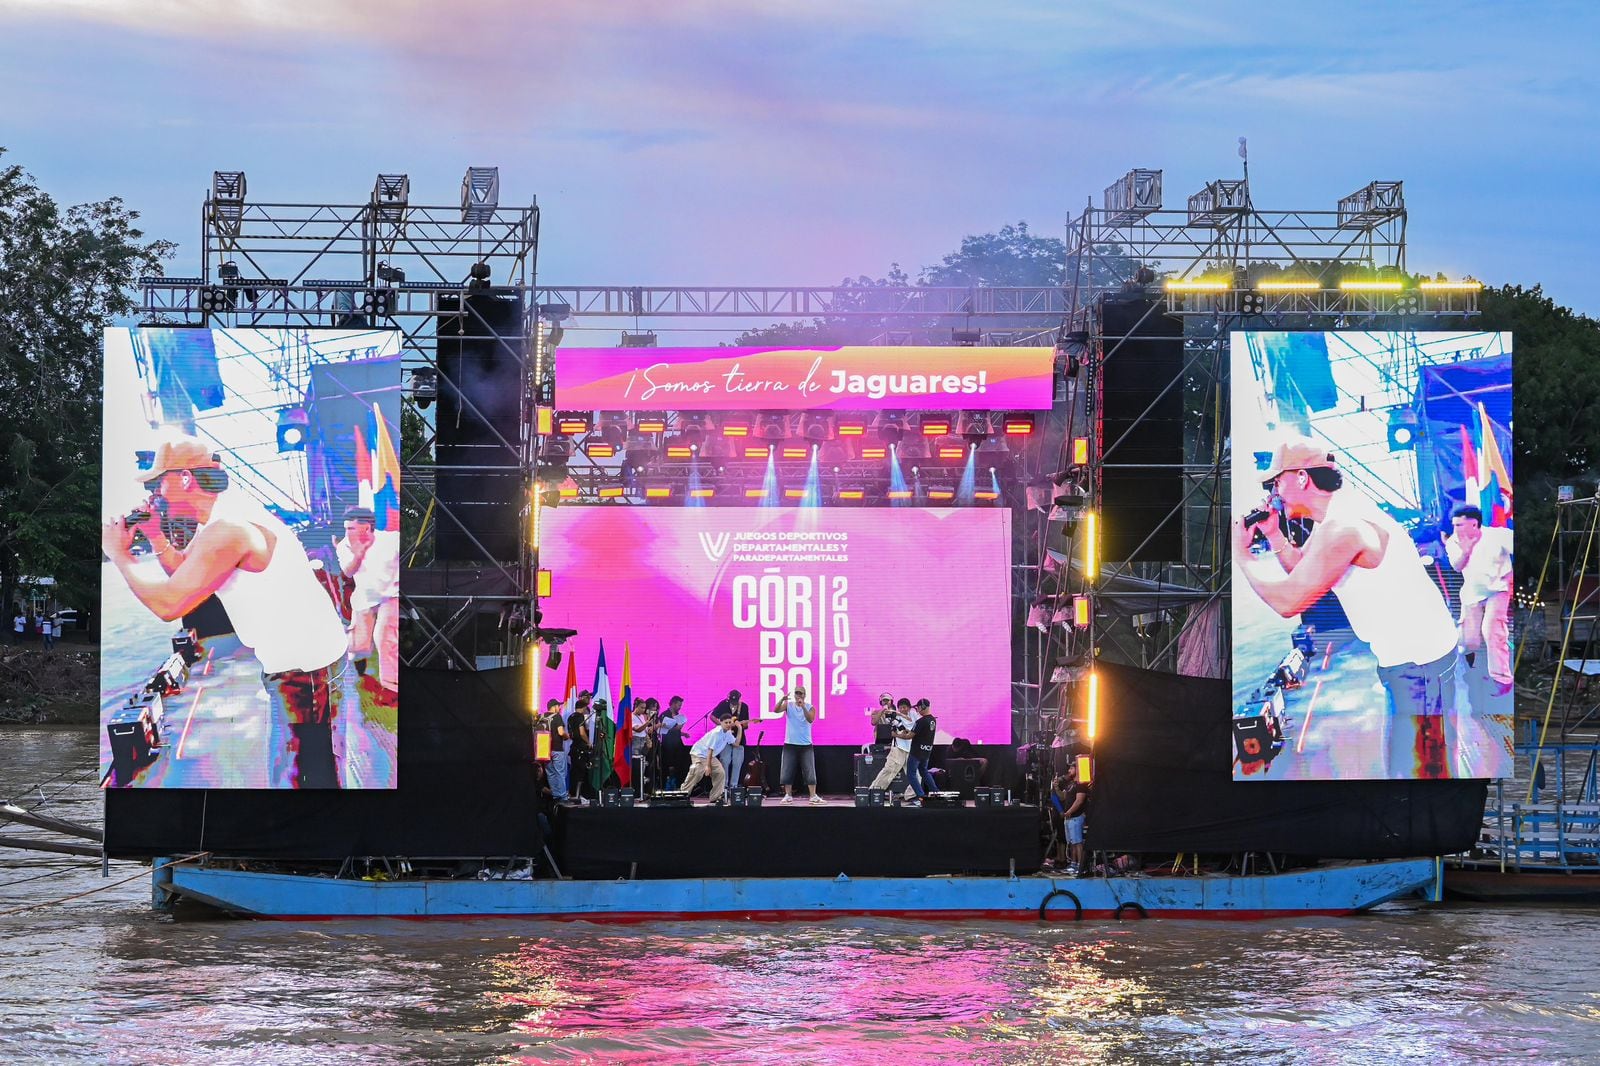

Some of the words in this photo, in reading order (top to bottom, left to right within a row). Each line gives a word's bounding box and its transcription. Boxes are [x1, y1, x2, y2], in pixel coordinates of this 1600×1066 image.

[624, 363, 715, 400] ¡Somos
[721, 363, 789, 393] tierra
[798, 357, 823, 398] de
[829, 369, 987, 399] Jaguares!
[733, 532, 777, 541] JUEGOS
[778, 532, 848, 541] DEPORTIVOS
[733, 543, 839, 552] DEPARTAMENTALES
[841, 543, 848, 552] Y
[733, 554, 848, 562] PARADEPARTAMENTALES
[732, 567, 813, 628] CÓR
[760, 631, 812, 665] DO
